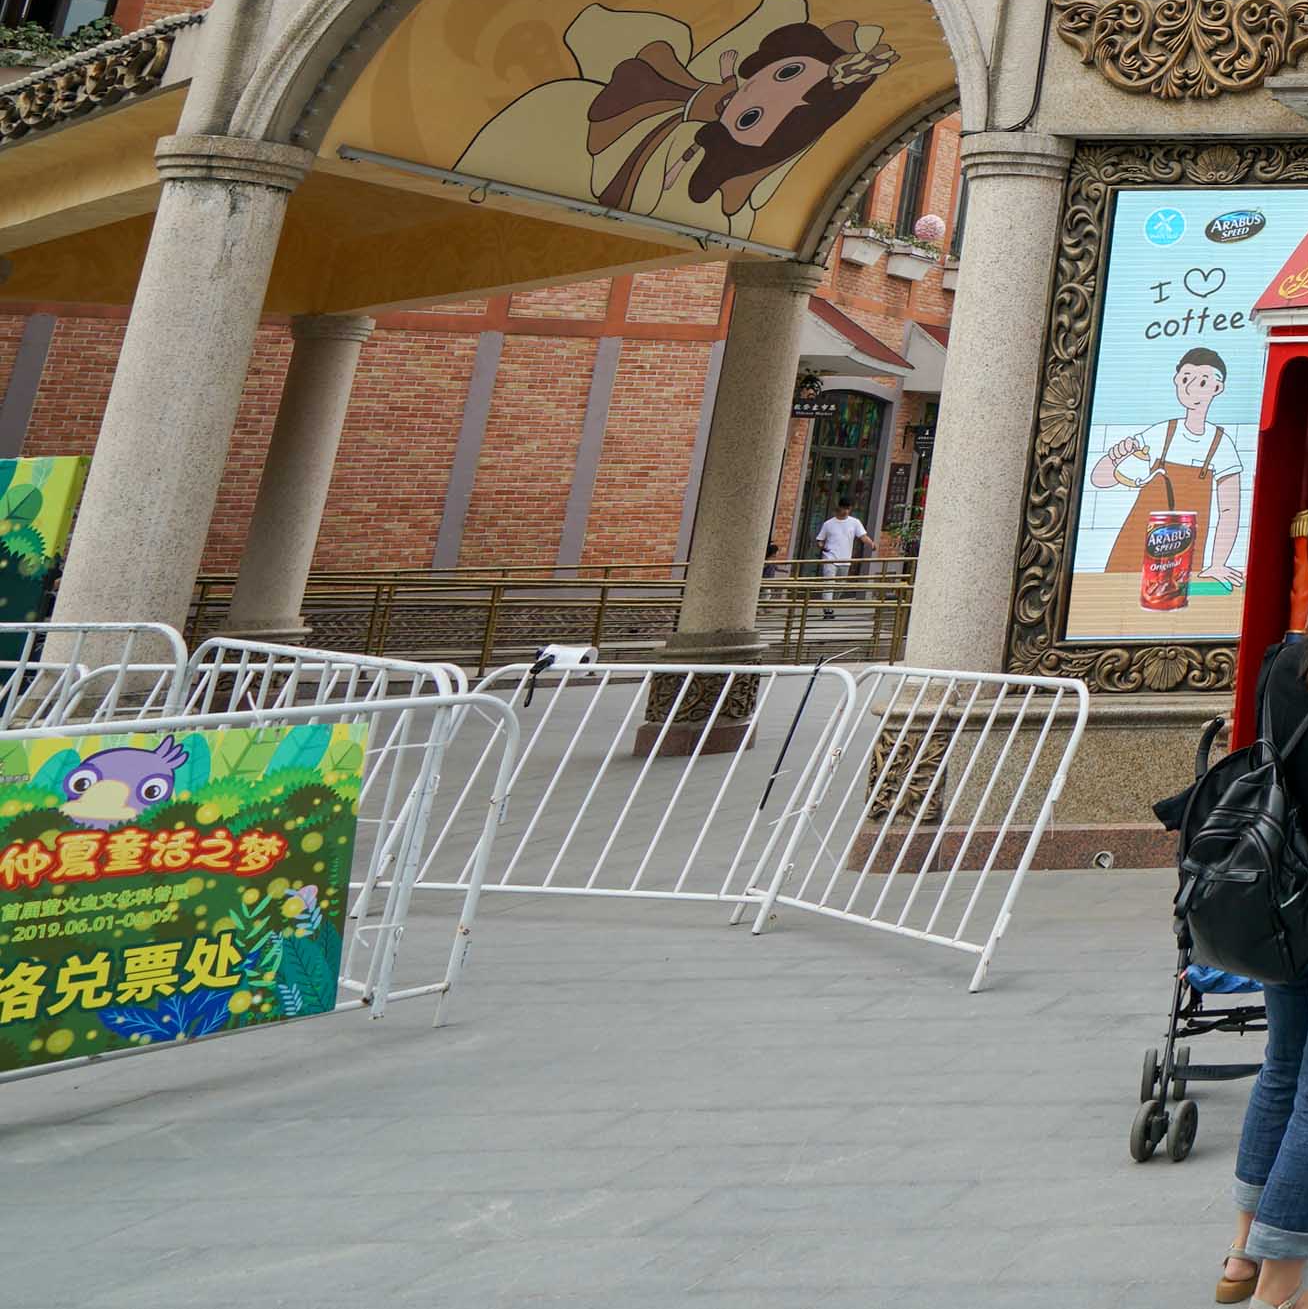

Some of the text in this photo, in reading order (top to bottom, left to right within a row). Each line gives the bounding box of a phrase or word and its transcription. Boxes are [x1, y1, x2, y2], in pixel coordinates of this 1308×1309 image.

[1210, 215, 1262, 233] ARABUS
[1220, 226, 1250, 238] SPEED
[1150, 281, 1172, 304] I
[1145, 307, 1246, 340] coffee
[1147, 528, 1192, 547] ARABUS
[1154, 541, 1182, 553] SPEED
[1, 829, 282, 887] 仲夏童话之梦
